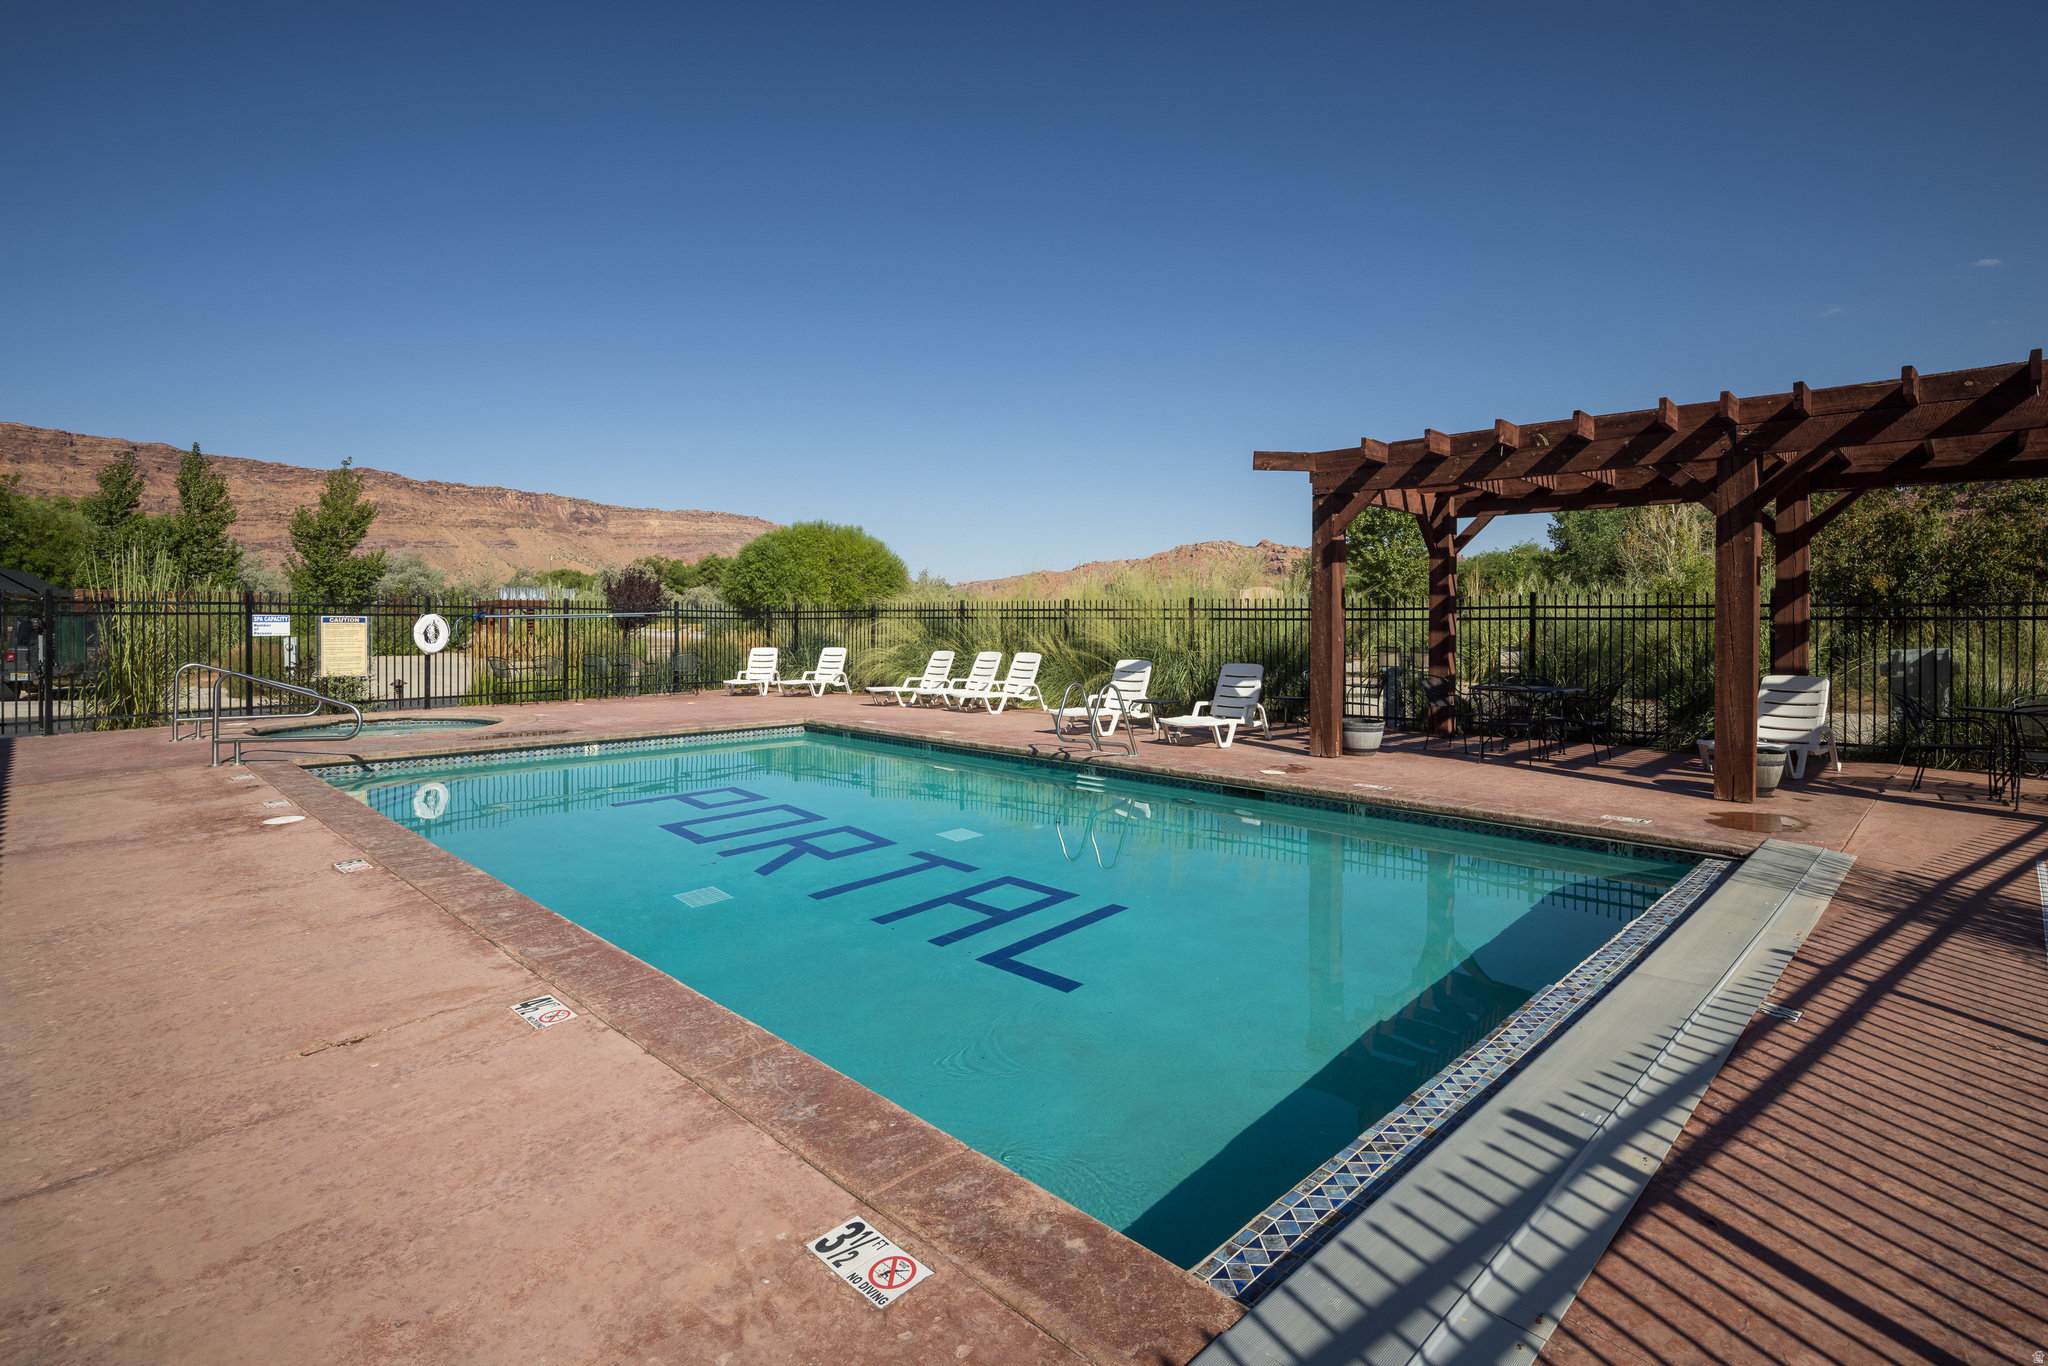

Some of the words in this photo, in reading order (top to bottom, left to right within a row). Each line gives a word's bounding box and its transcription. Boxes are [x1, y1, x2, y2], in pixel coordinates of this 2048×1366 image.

[612, 787, 1129, 994] PORTAL
[871, 1239, 890, 1251] FT
[846, 1272, 863, 1285] NO
[858, 1281, 890, 1306] DIVING
